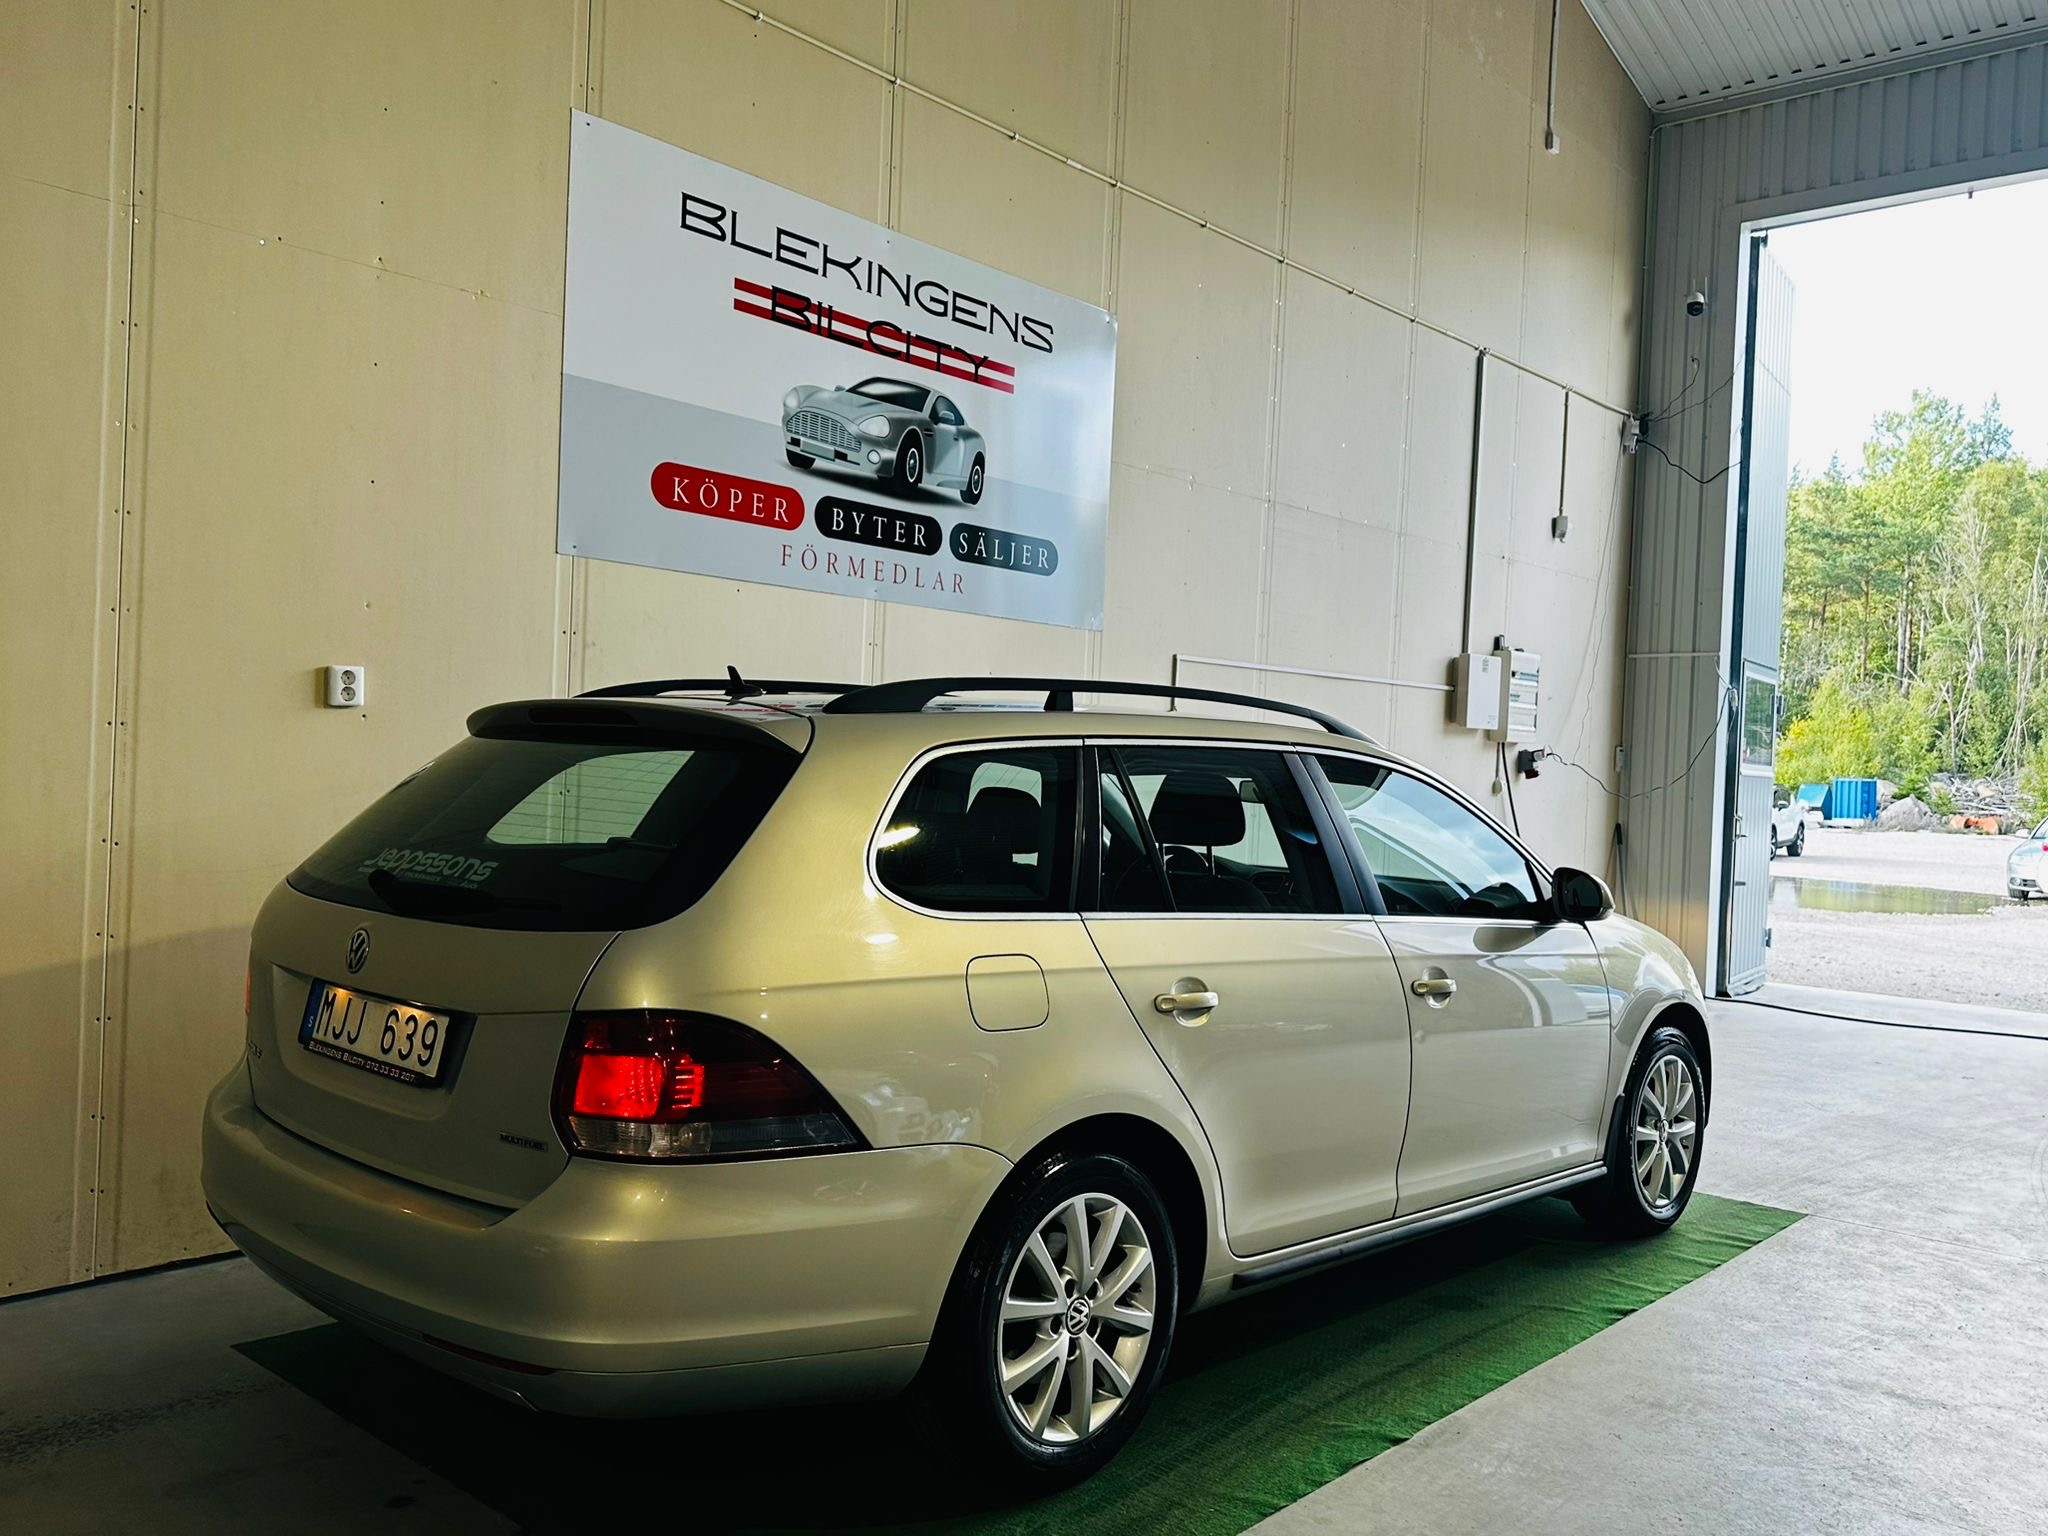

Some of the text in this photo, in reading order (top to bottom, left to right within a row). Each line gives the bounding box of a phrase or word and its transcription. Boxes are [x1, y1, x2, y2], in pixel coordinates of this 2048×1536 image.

[680, 191, 1055, 354] BLEKINGENS
[770, 285, 990, 384] BILCITY
[672, 476, 1050, 570] KÖPER BYTER SÄLJER
[780, 543, 965, 595] FÖRMEDLAR
[316, 990, 439, 1067] MJJ 639
